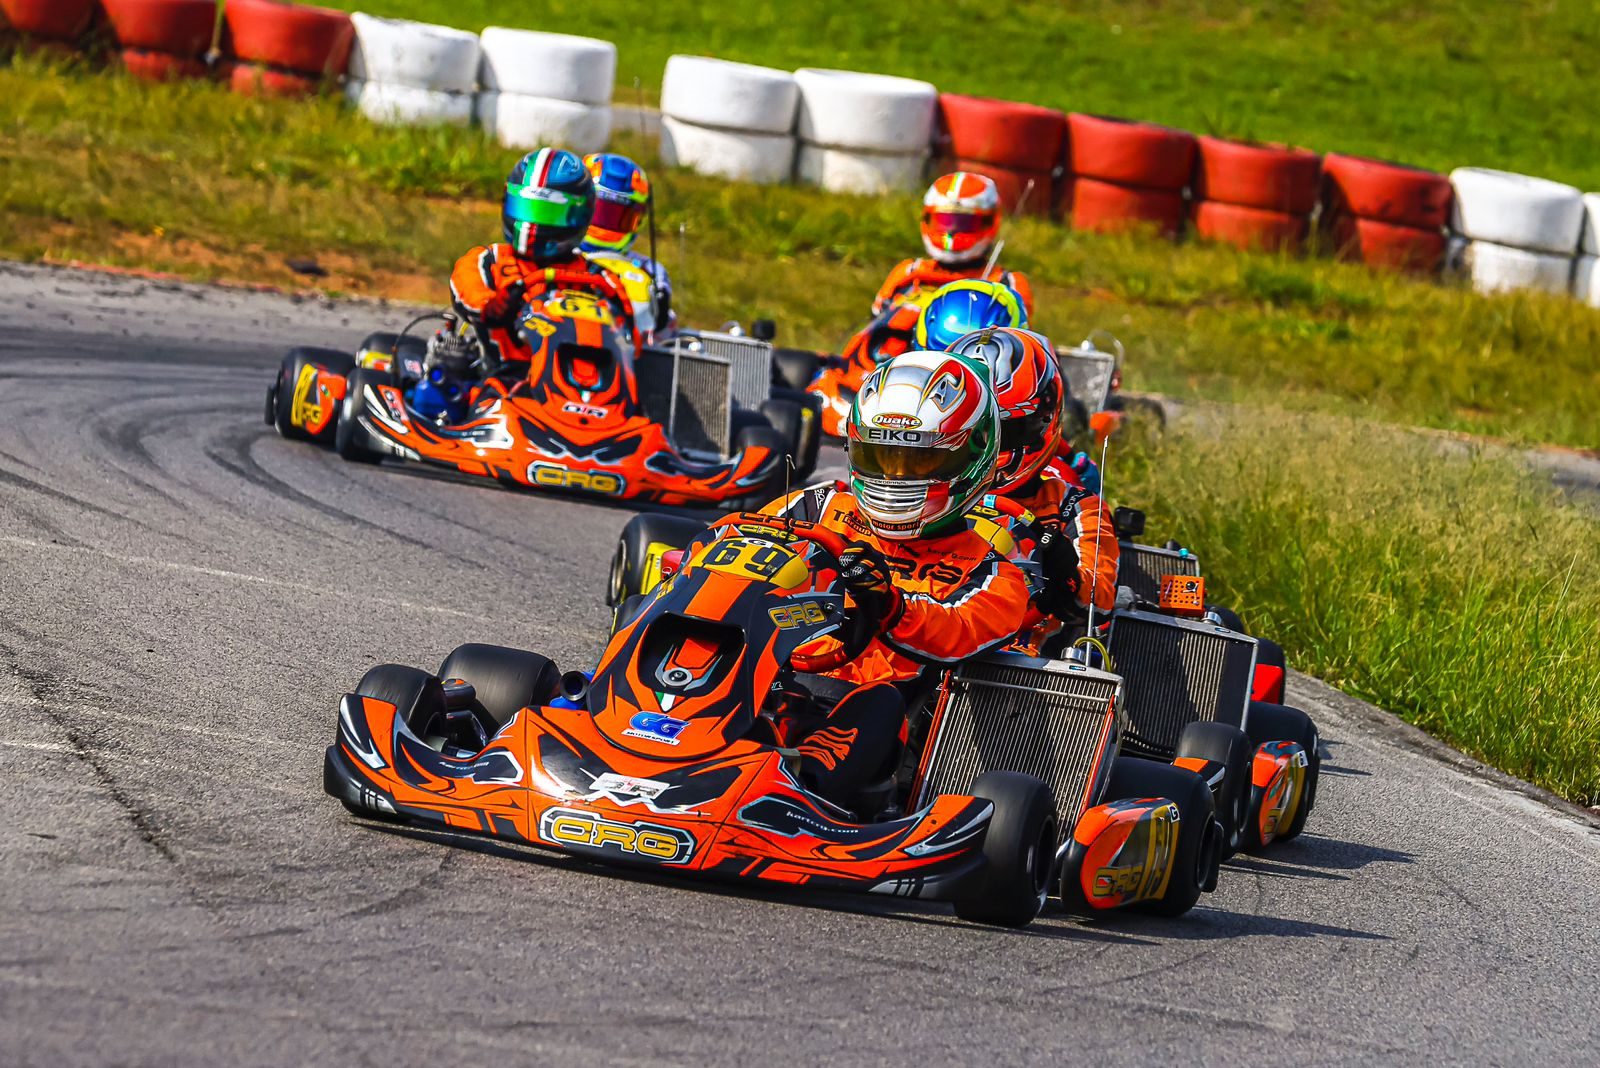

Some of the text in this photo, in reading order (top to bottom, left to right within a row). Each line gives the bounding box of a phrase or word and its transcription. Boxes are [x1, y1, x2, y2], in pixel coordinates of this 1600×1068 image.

[875, 414, 921, 428] Quake
[868, 428, 921, 442] EIKO
[535, 467, 618, 493] CRG
[739, 511, 815, 530] CRG
[872, 517, 921, 531] motor sport
[738, 524, 799, 542] CRG
[702, 540, 790, 576] 69
[767, 600, 828, 631] CRG
[550, 817, 680, 861] CRG
